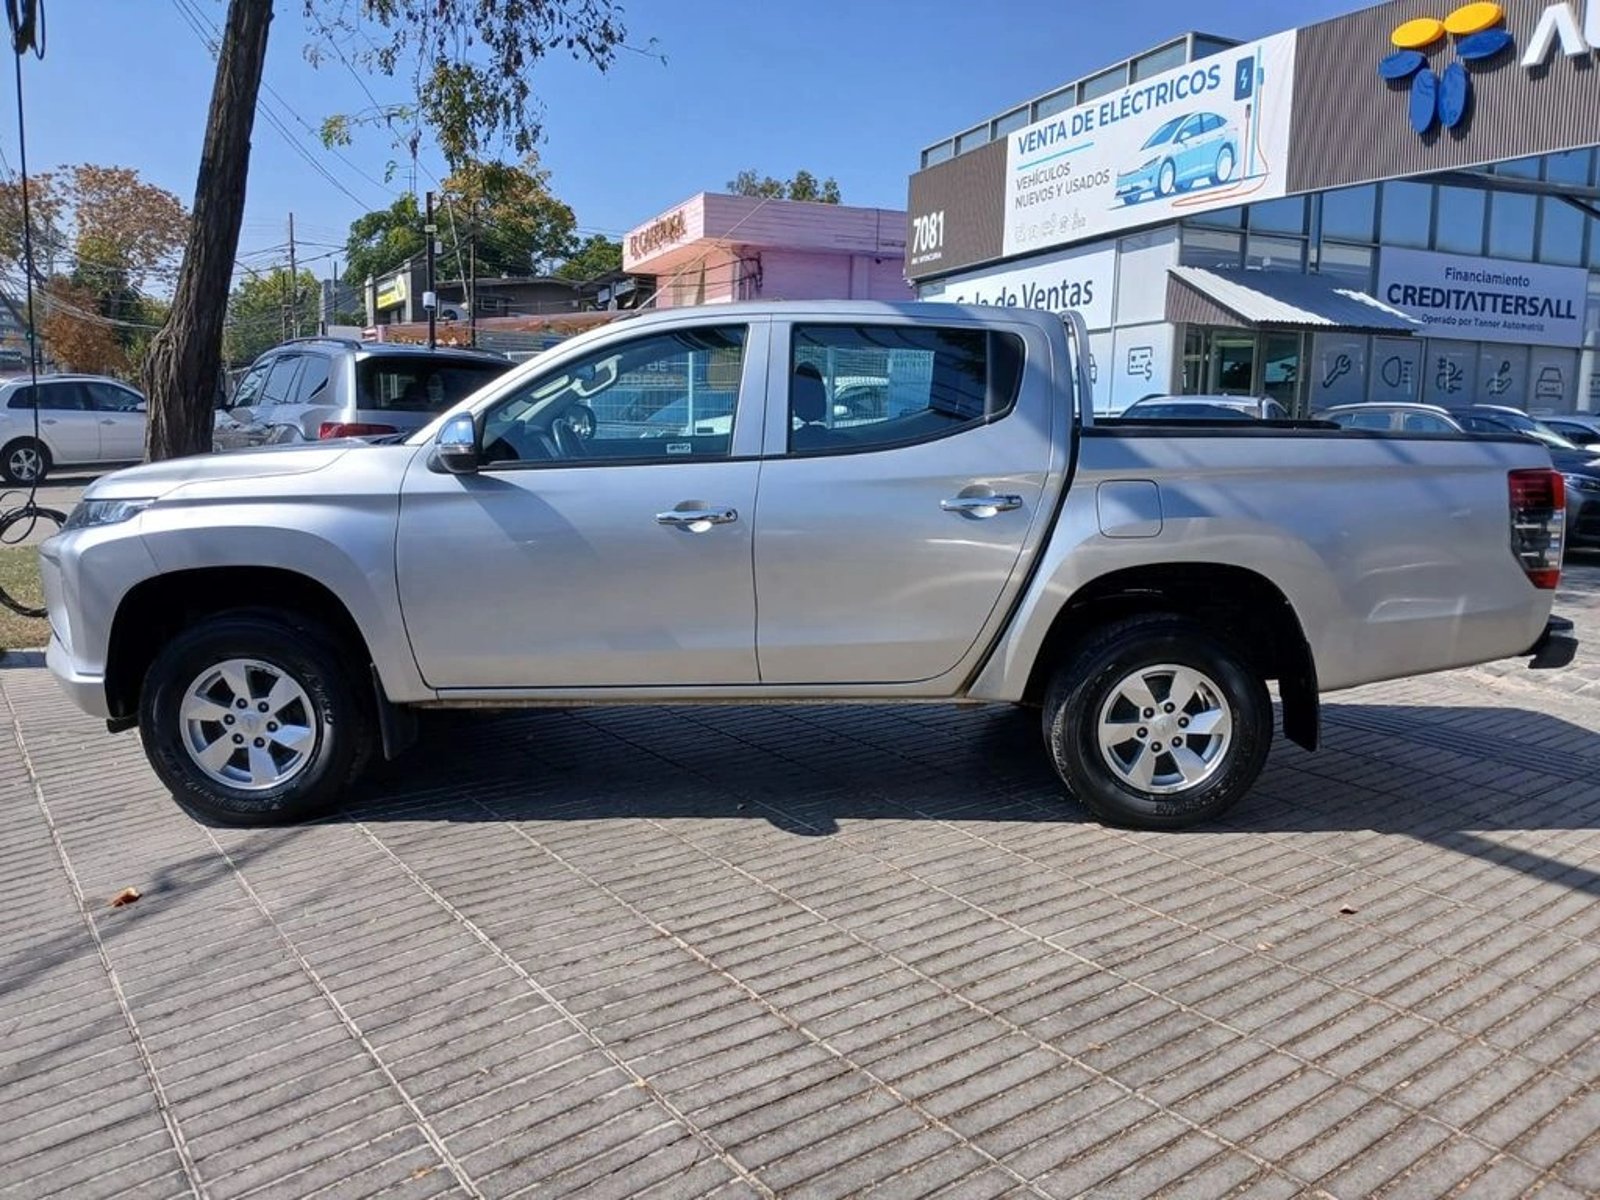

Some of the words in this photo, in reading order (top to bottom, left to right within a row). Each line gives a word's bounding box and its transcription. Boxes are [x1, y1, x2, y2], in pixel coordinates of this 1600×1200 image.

[1017, 120, 1068, 155] VENTA
[1072, 109, 1095, 136] DE
[1099, 64, 1221, 127] ELÉCTRICOS
[1014, 187, 1055, 210] NUEVOS
[1055, 182, 1065, 198] Y
[1065, 169, 1110, 194] USADOS
[1015, 162, 1071, 191] VEHÍCULOS
[913, 210, 945, 254] 7081
[1022, 278, 1093, 311] Ventas
[1444, 267, 1530, 288] Financiamiento
[1387, 282, 1576, 320] CREDITATTERSALL
[1421, 314, 1457, 326] Operado
